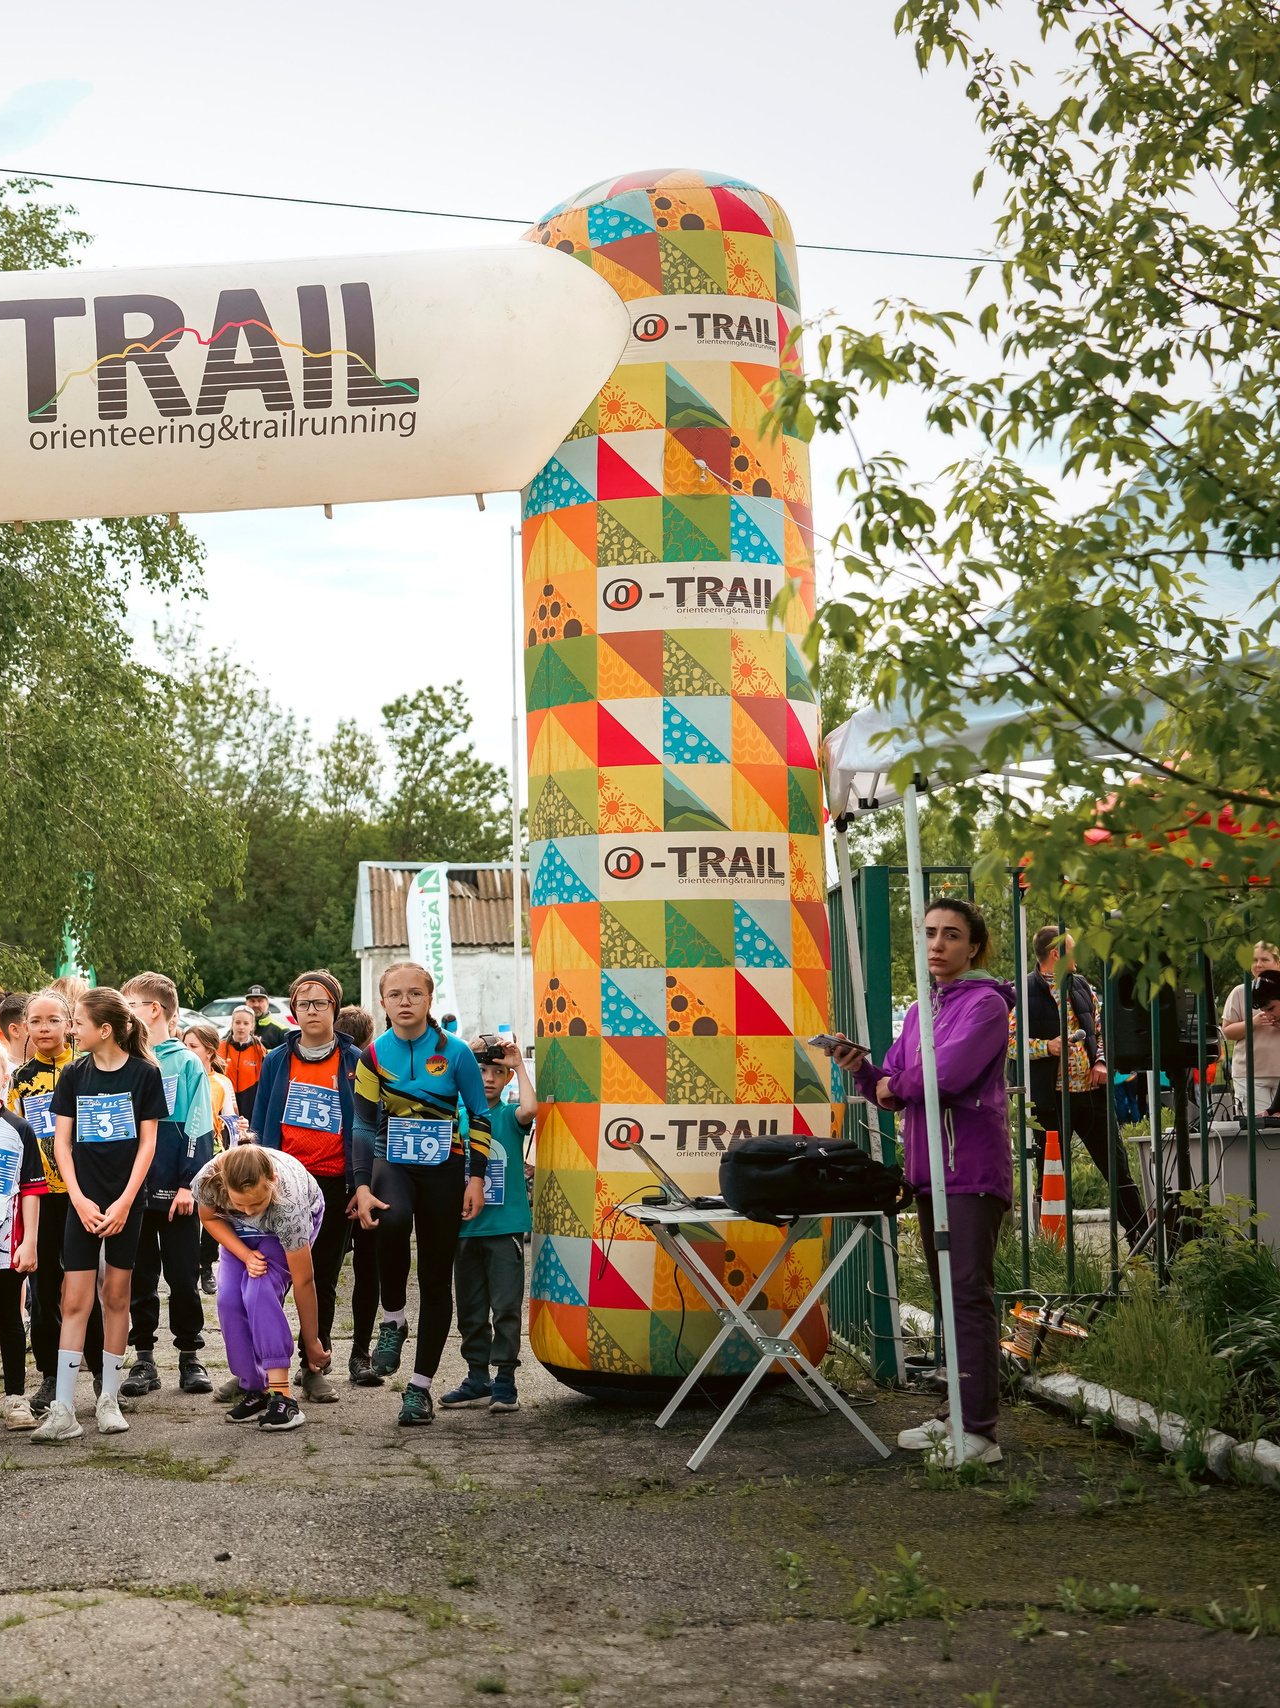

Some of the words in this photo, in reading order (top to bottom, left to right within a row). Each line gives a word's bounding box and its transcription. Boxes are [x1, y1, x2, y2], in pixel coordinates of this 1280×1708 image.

[697, 338, 777, 353] orienteering&trailrunning
[29, 407, 418, 451] orienteering&trailrunning
[678, 877, 785, 886] orienteering&trailrunning
[97, 1113, 114, 1138] 3
[296, 1100, 331, 1127] 13
[401, 1136, 440, 1161] 19
